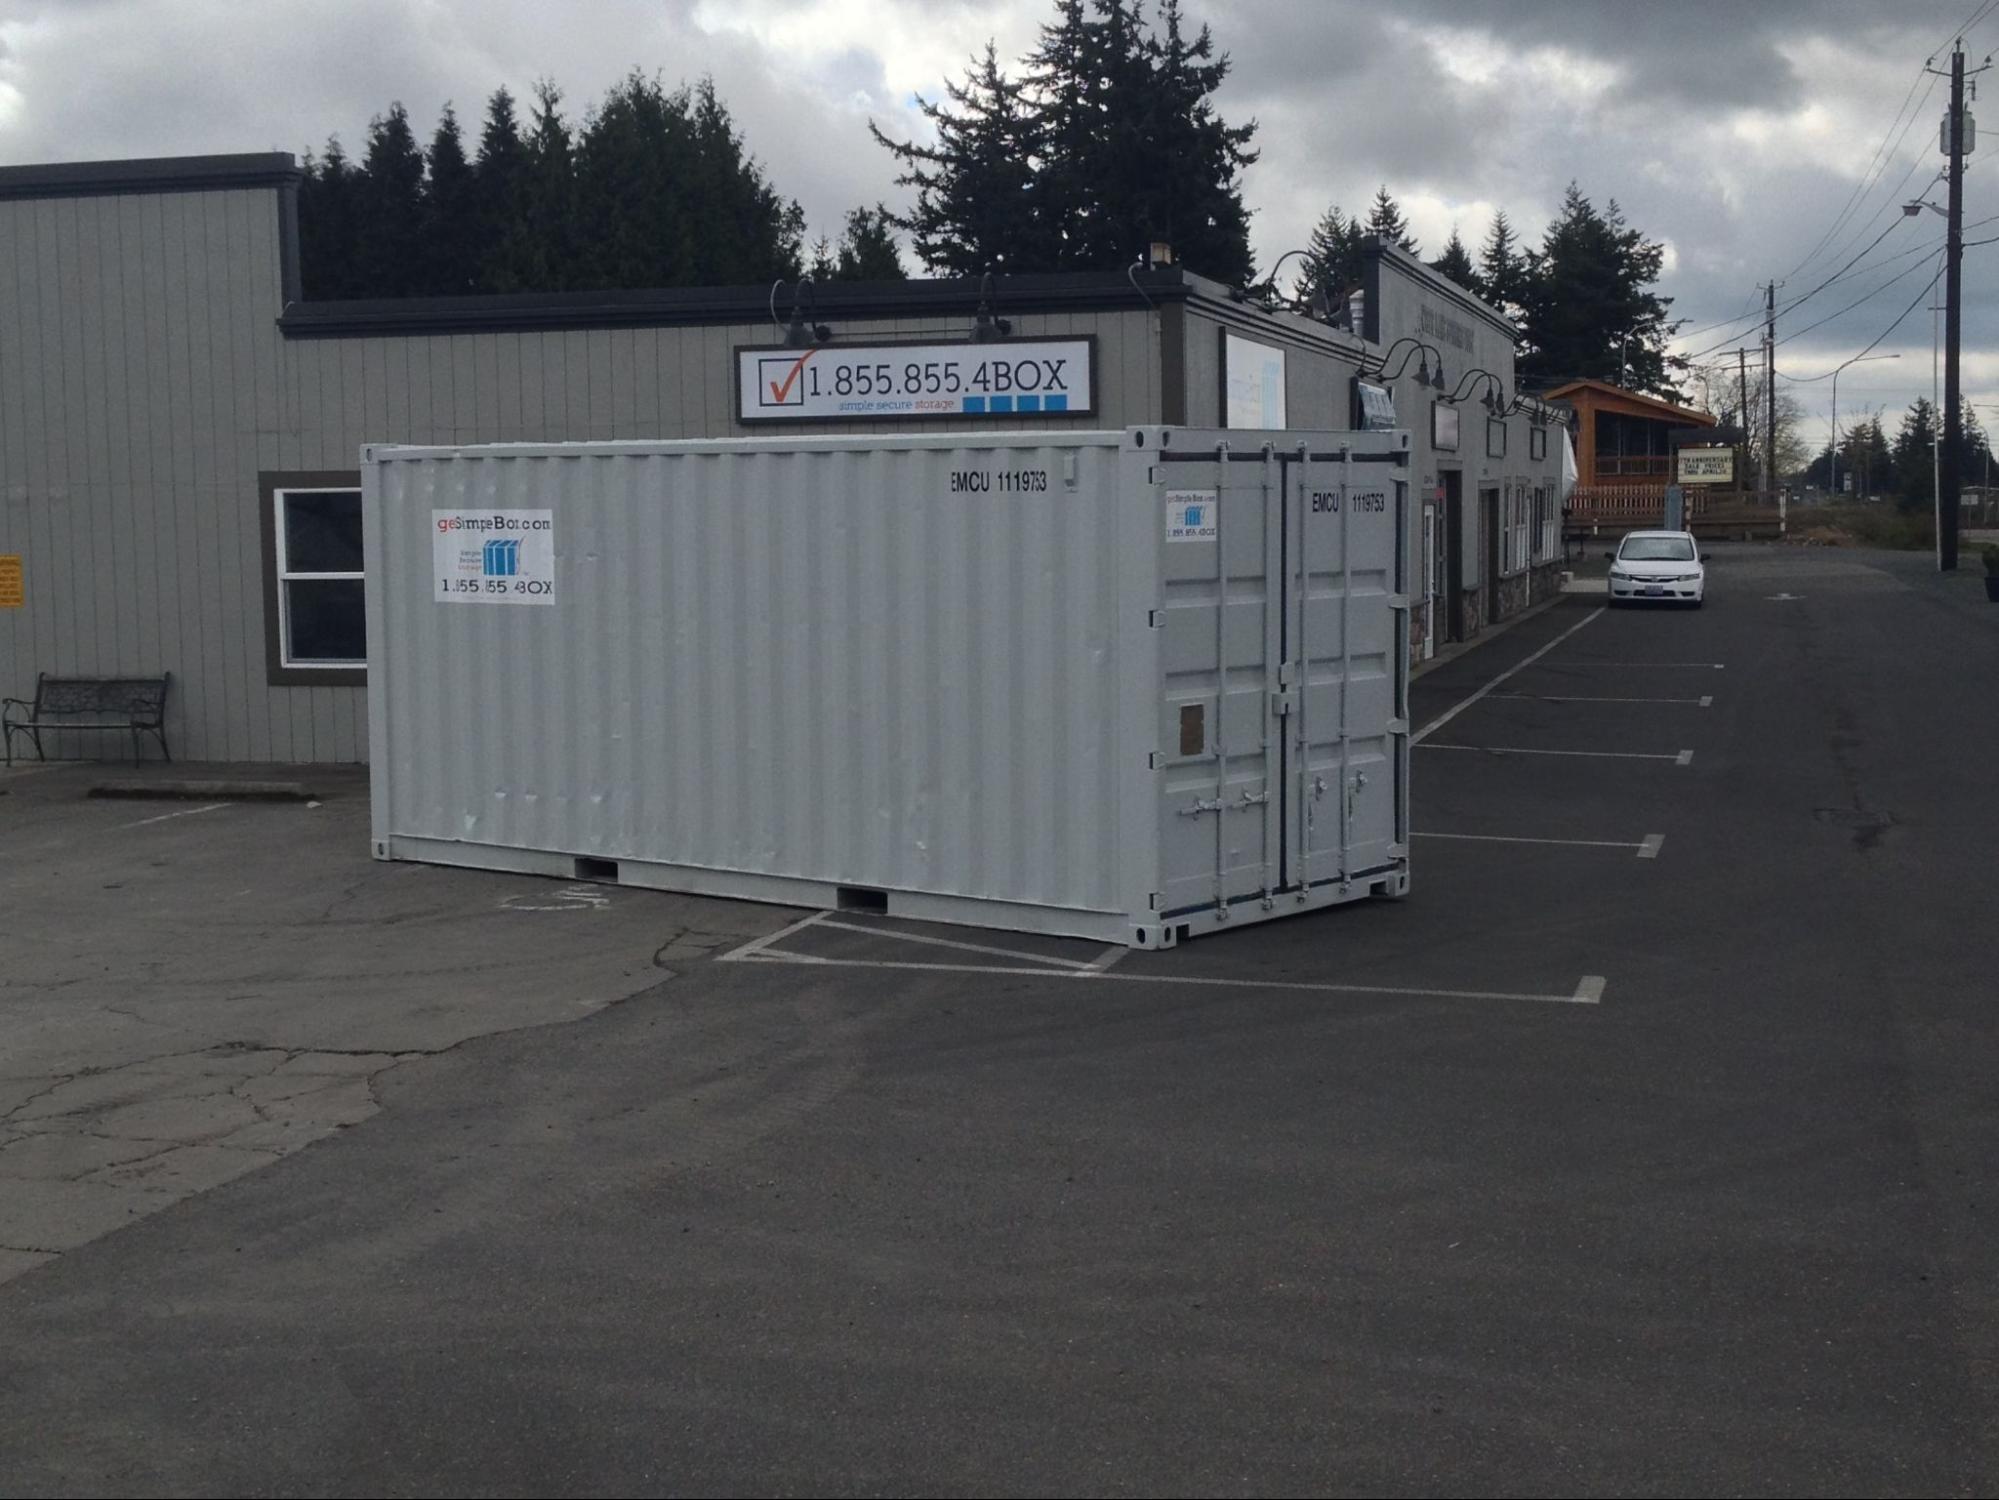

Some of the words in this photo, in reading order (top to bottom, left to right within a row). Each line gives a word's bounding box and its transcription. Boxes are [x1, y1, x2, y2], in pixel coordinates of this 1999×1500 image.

[809, 359, 1068, 397] 1.855.855.4BOX
[839, 400, 874, 412] simple
[876, 400, 913, 411] secure
[914, 399, 955, 411] storage
[951, 471, 990, 492] EMCU
[998, 470, 1047, 492] 1119753
[1312, 492, 1339, 512] EMCU
[1353, 493, 1384, 512] 1119753
